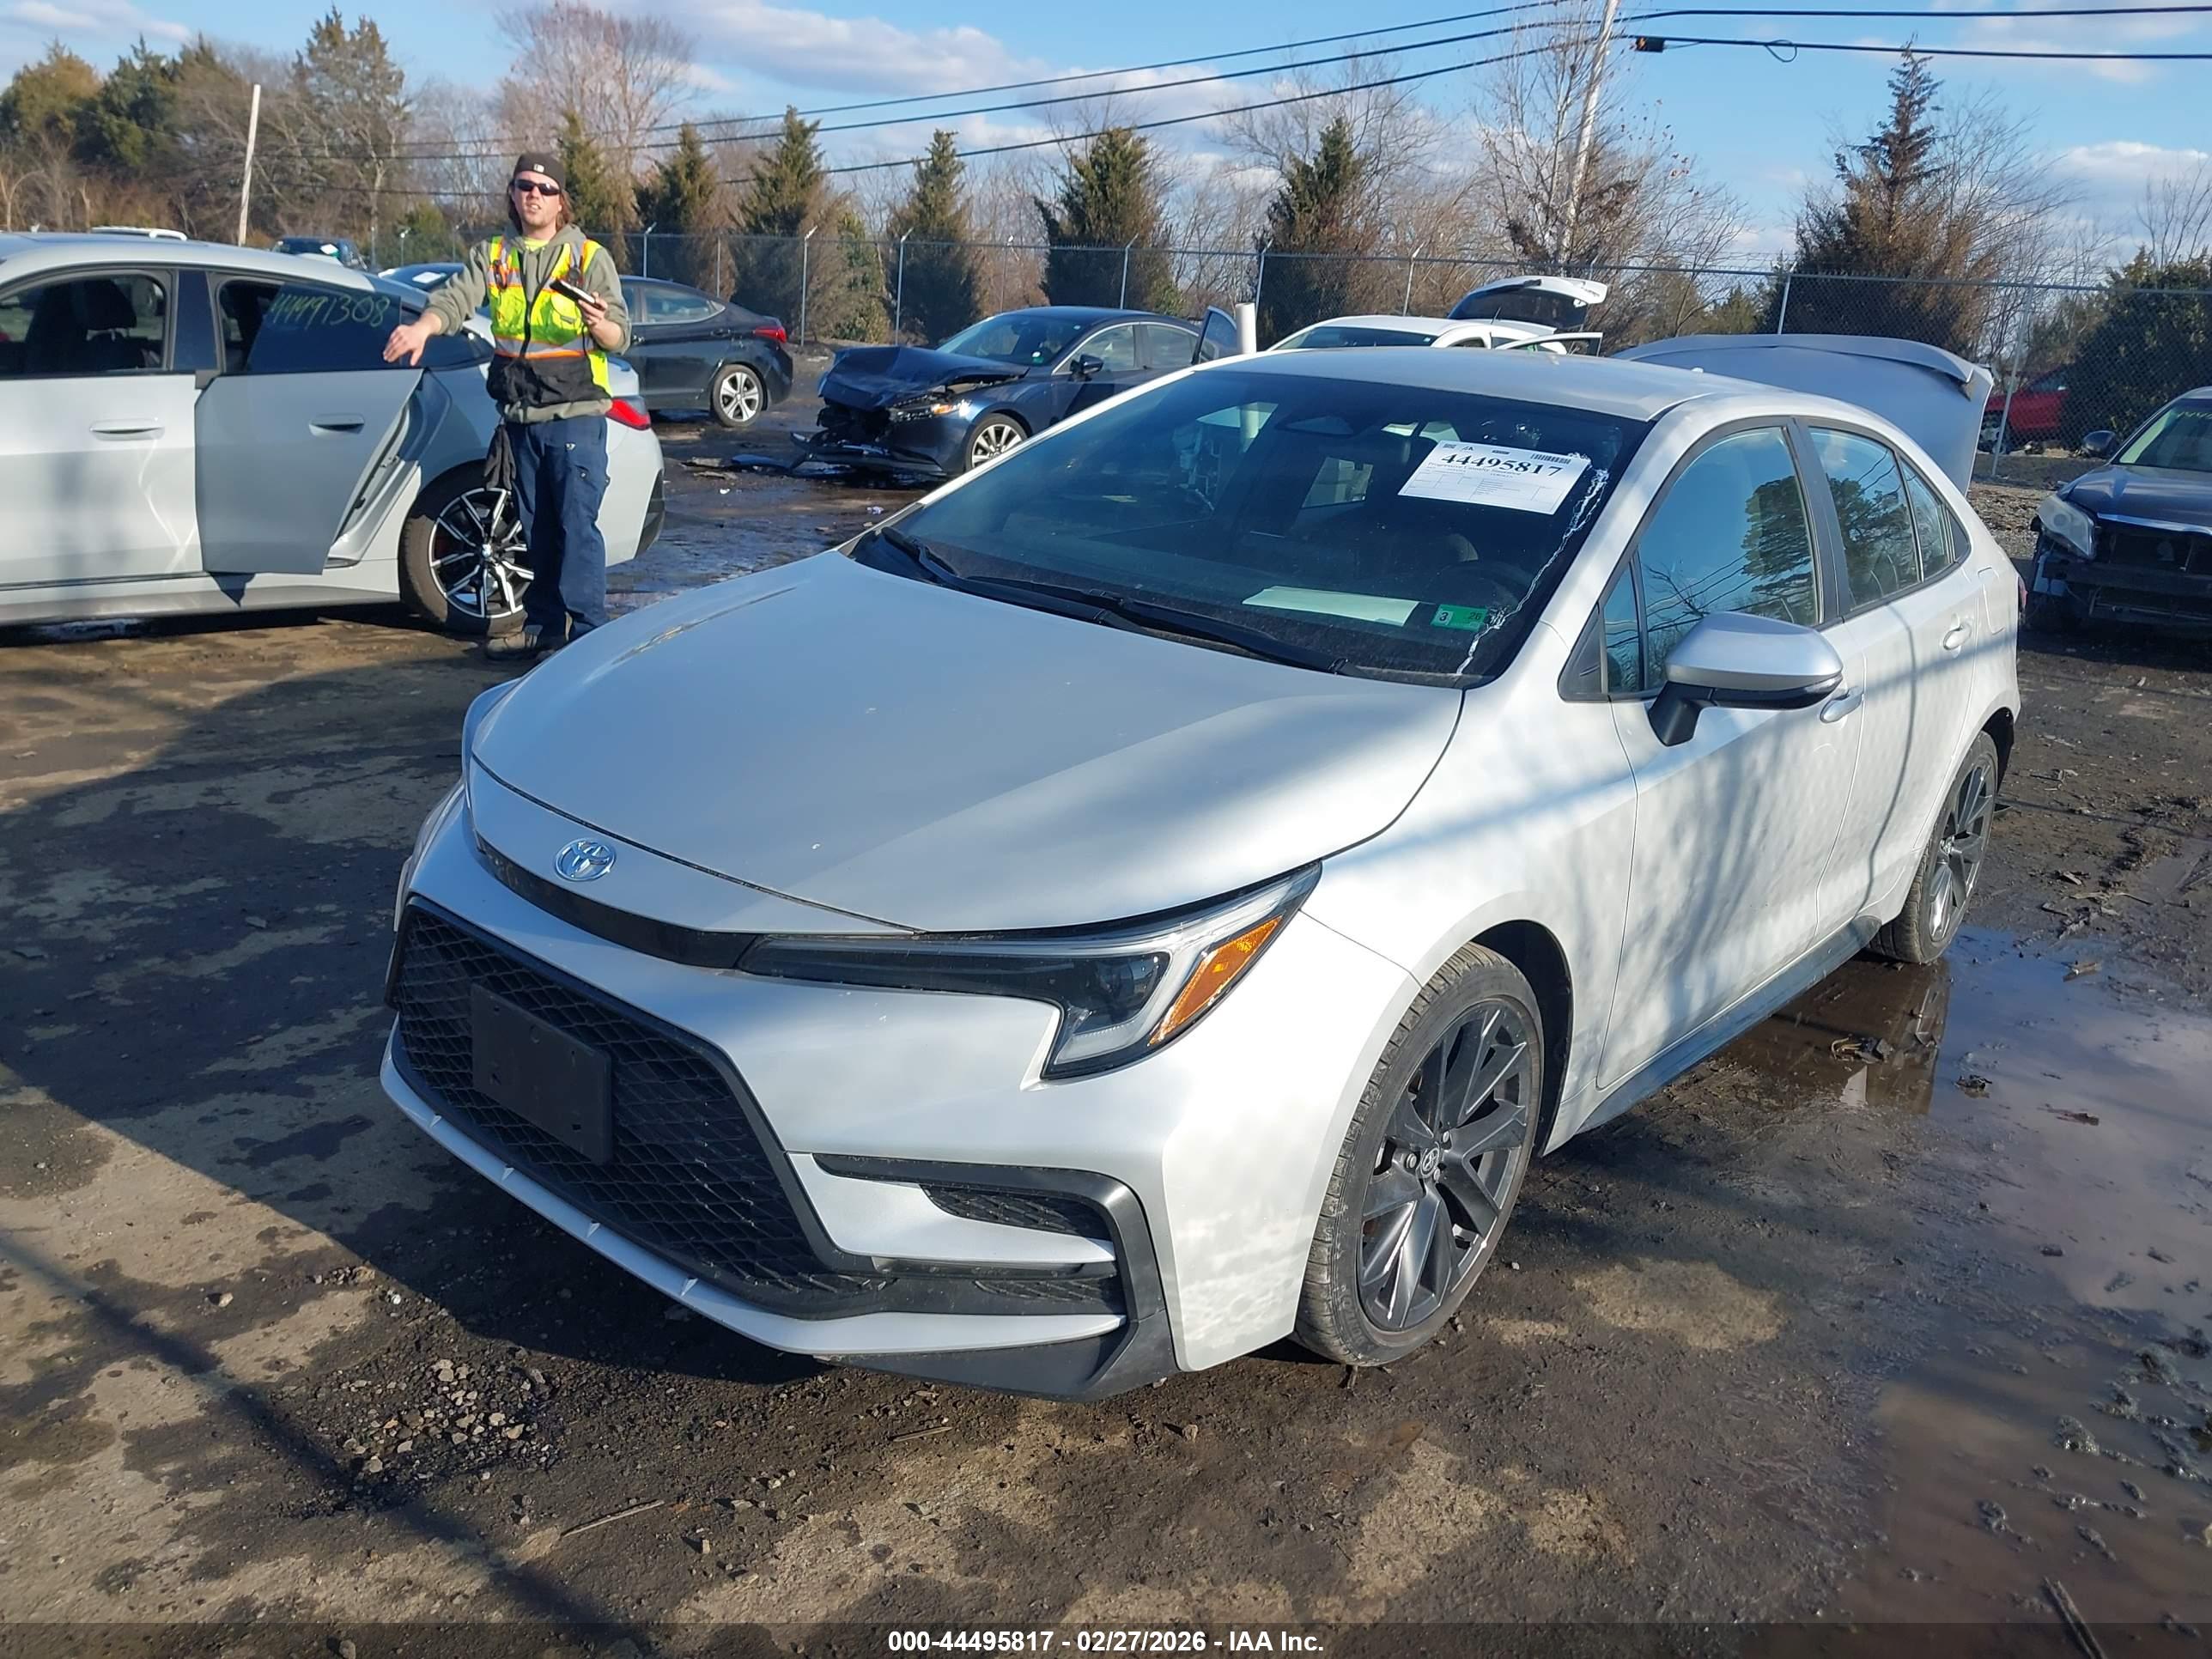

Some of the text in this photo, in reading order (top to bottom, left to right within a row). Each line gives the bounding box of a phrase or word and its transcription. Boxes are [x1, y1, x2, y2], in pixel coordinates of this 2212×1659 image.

[271, 294, 391, 330] 44491308
[1441, 453, 1563, 477] 44495817
[1439, 611, 1449, 622] 3
